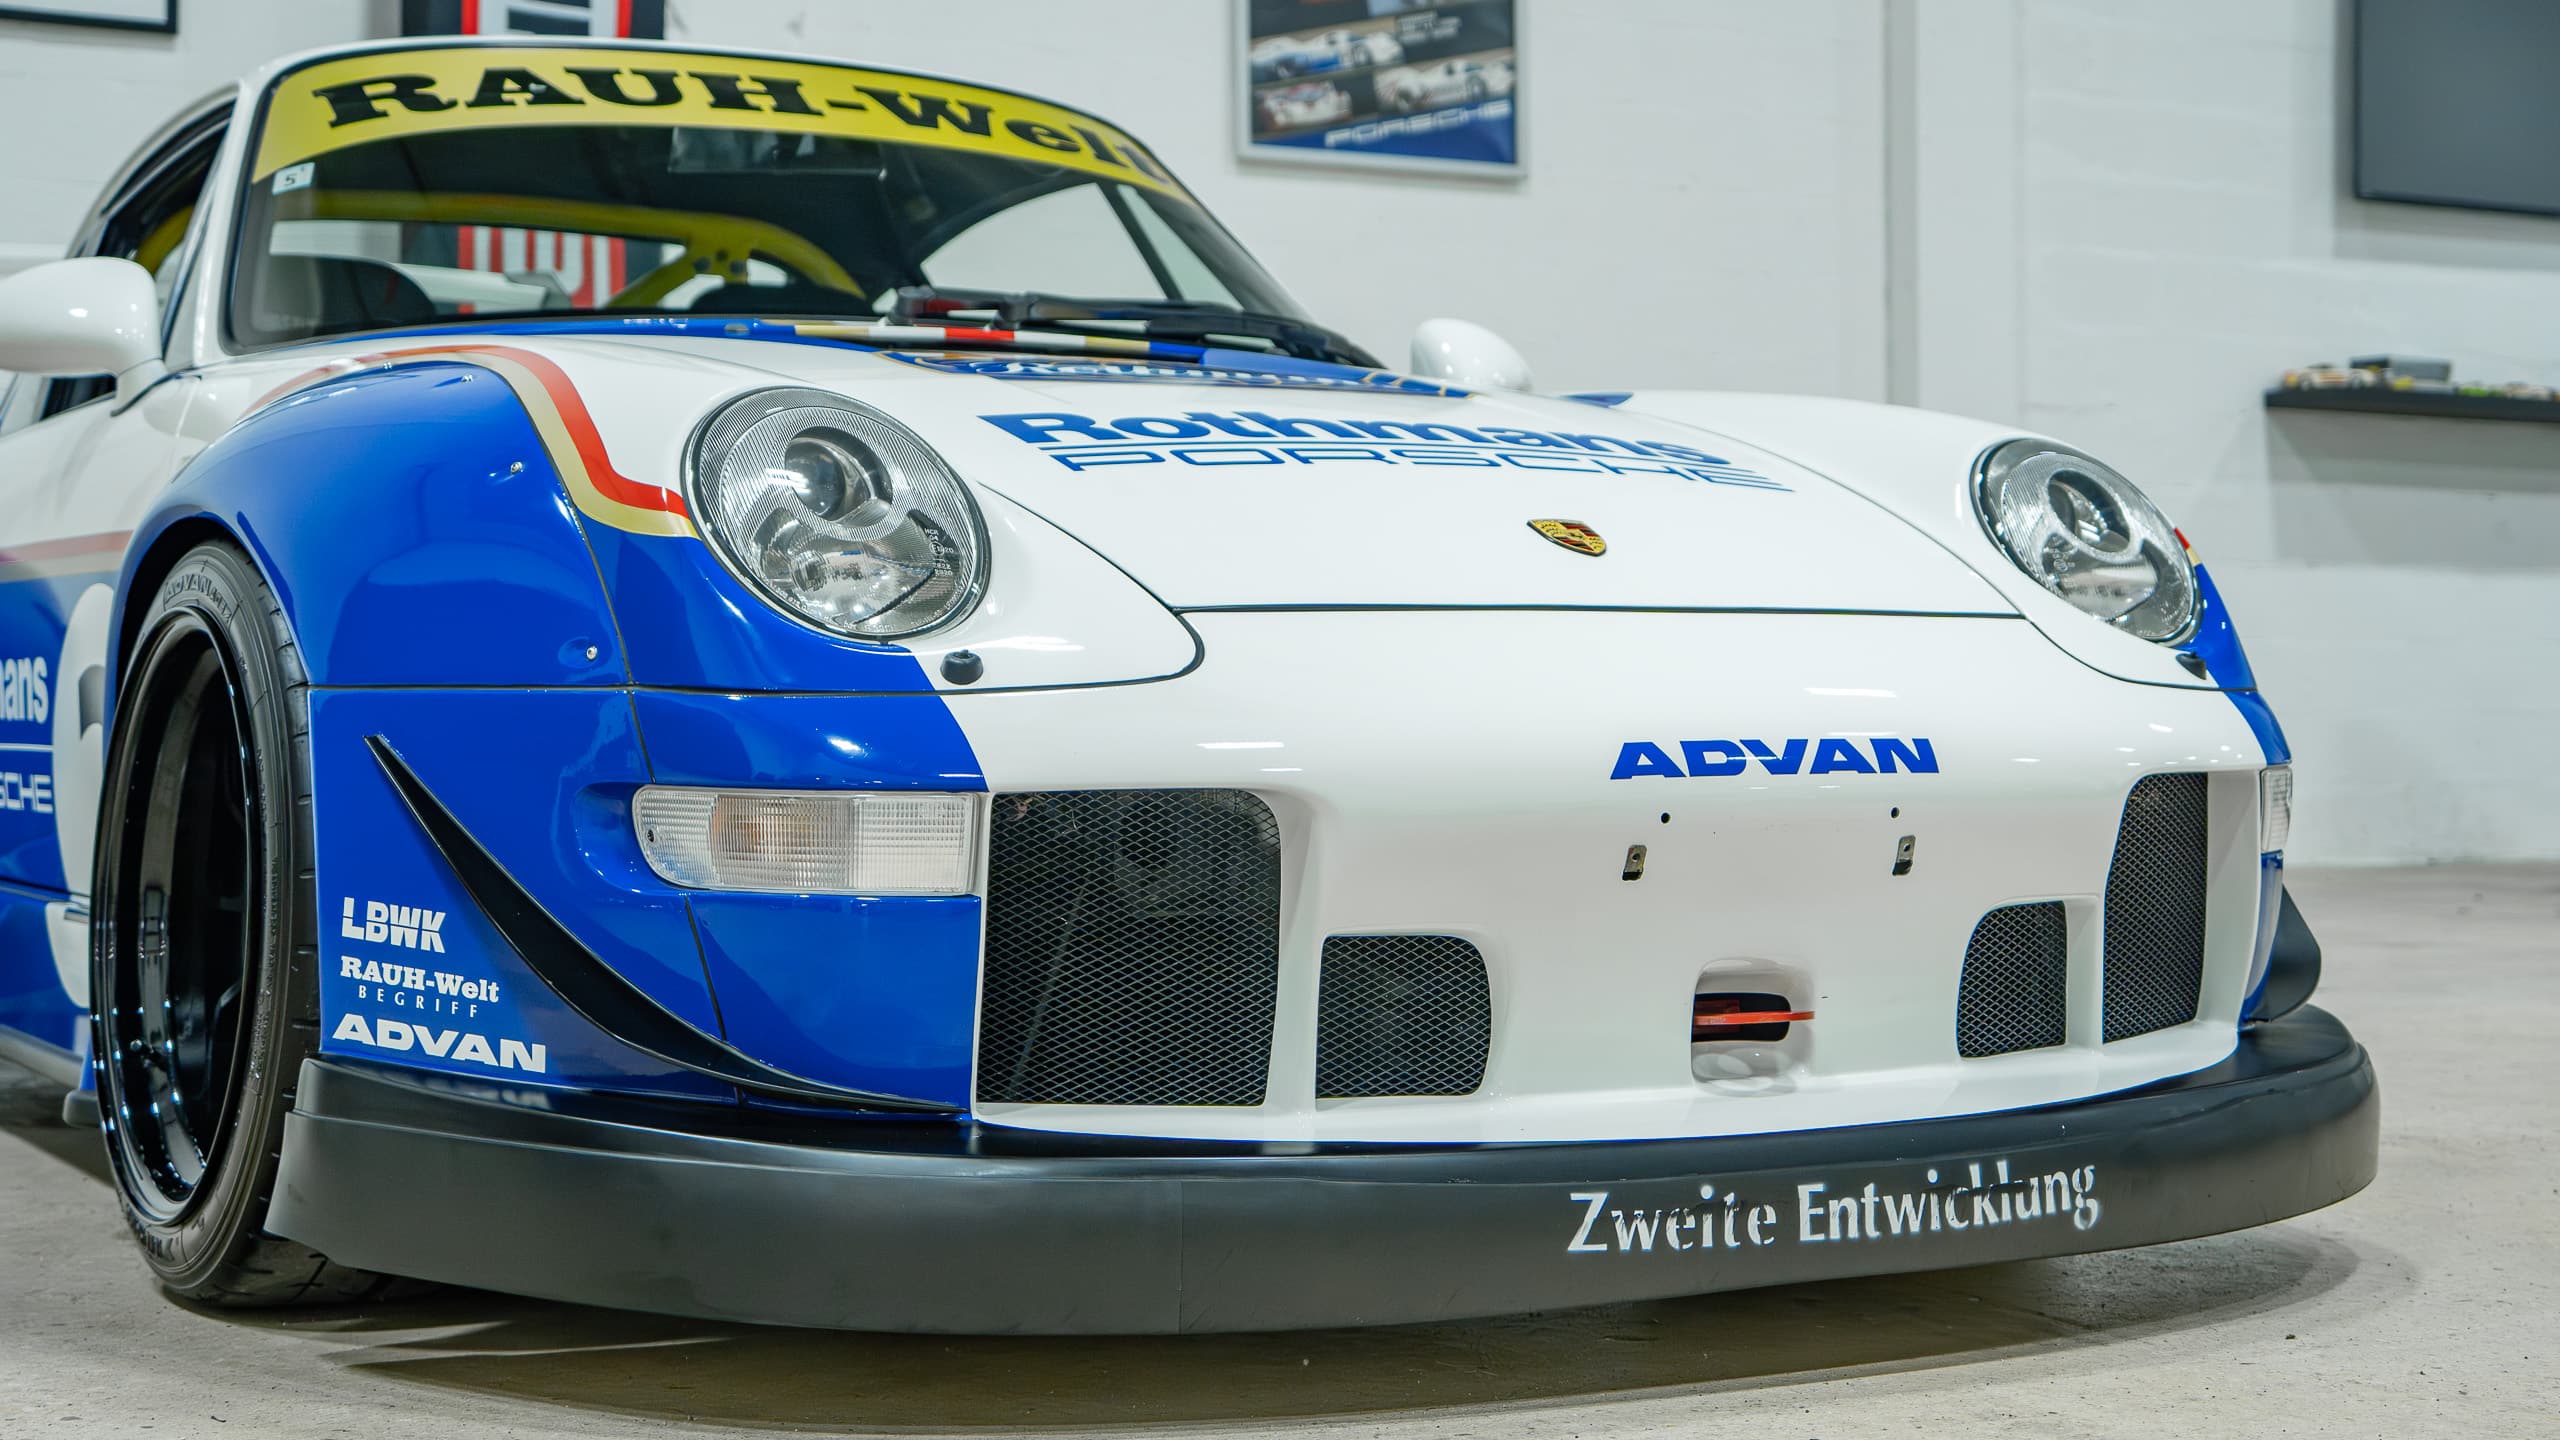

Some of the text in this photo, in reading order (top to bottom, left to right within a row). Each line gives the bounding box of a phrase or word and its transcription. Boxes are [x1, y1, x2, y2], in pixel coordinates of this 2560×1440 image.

[312, 66, 1171, 187] RAUH-Welt
[979, 410, 1730, 466] Rothmans
[1049, 446, 1797, 494] PORSCHE
[0, 656, 49, 724] ans
[1610, 738, 1939, 780] ADVAN
[341, 896, 446, 953] LBWK
[340, 955, 500, 1004] RAUH-Welt
[358, 985, 478, 1018] BEGRIFF
[331, 1013, 546, 1074] ADVAN
[1567, 1160, 2098, 1252] Zweite Entwicklung
